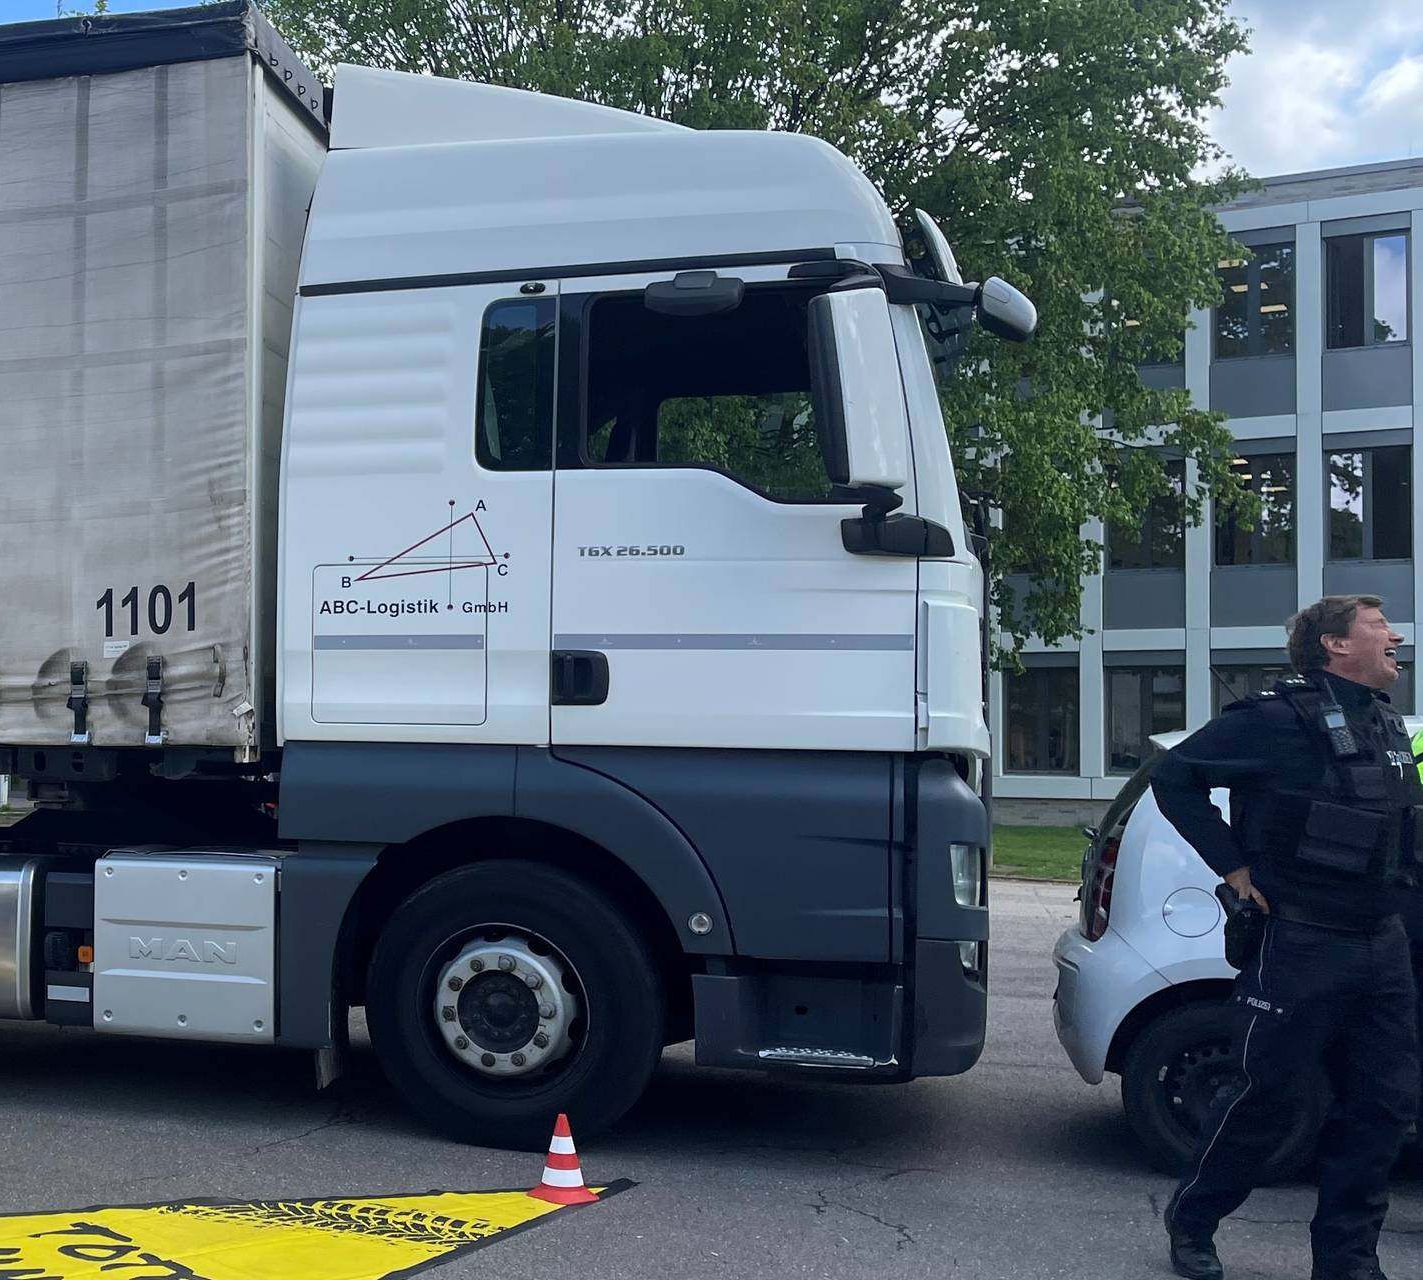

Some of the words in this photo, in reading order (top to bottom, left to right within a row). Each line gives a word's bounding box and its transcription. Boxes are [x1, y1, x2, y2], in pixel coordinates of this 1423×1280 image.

[475, 499, 487, 512] A
[577, 545, 613, 557] TGX
[616, 545, 685, 556] 26.500
[497, 564, 508, 576] C
[341, 576, 352, 588] B
[96, 581, 196, 637] 1101
[319, 599, 439, 618] ABC-Logistik
[462, 601, 508, 613] GmbH
[129, 936, 237, 964] MAN
